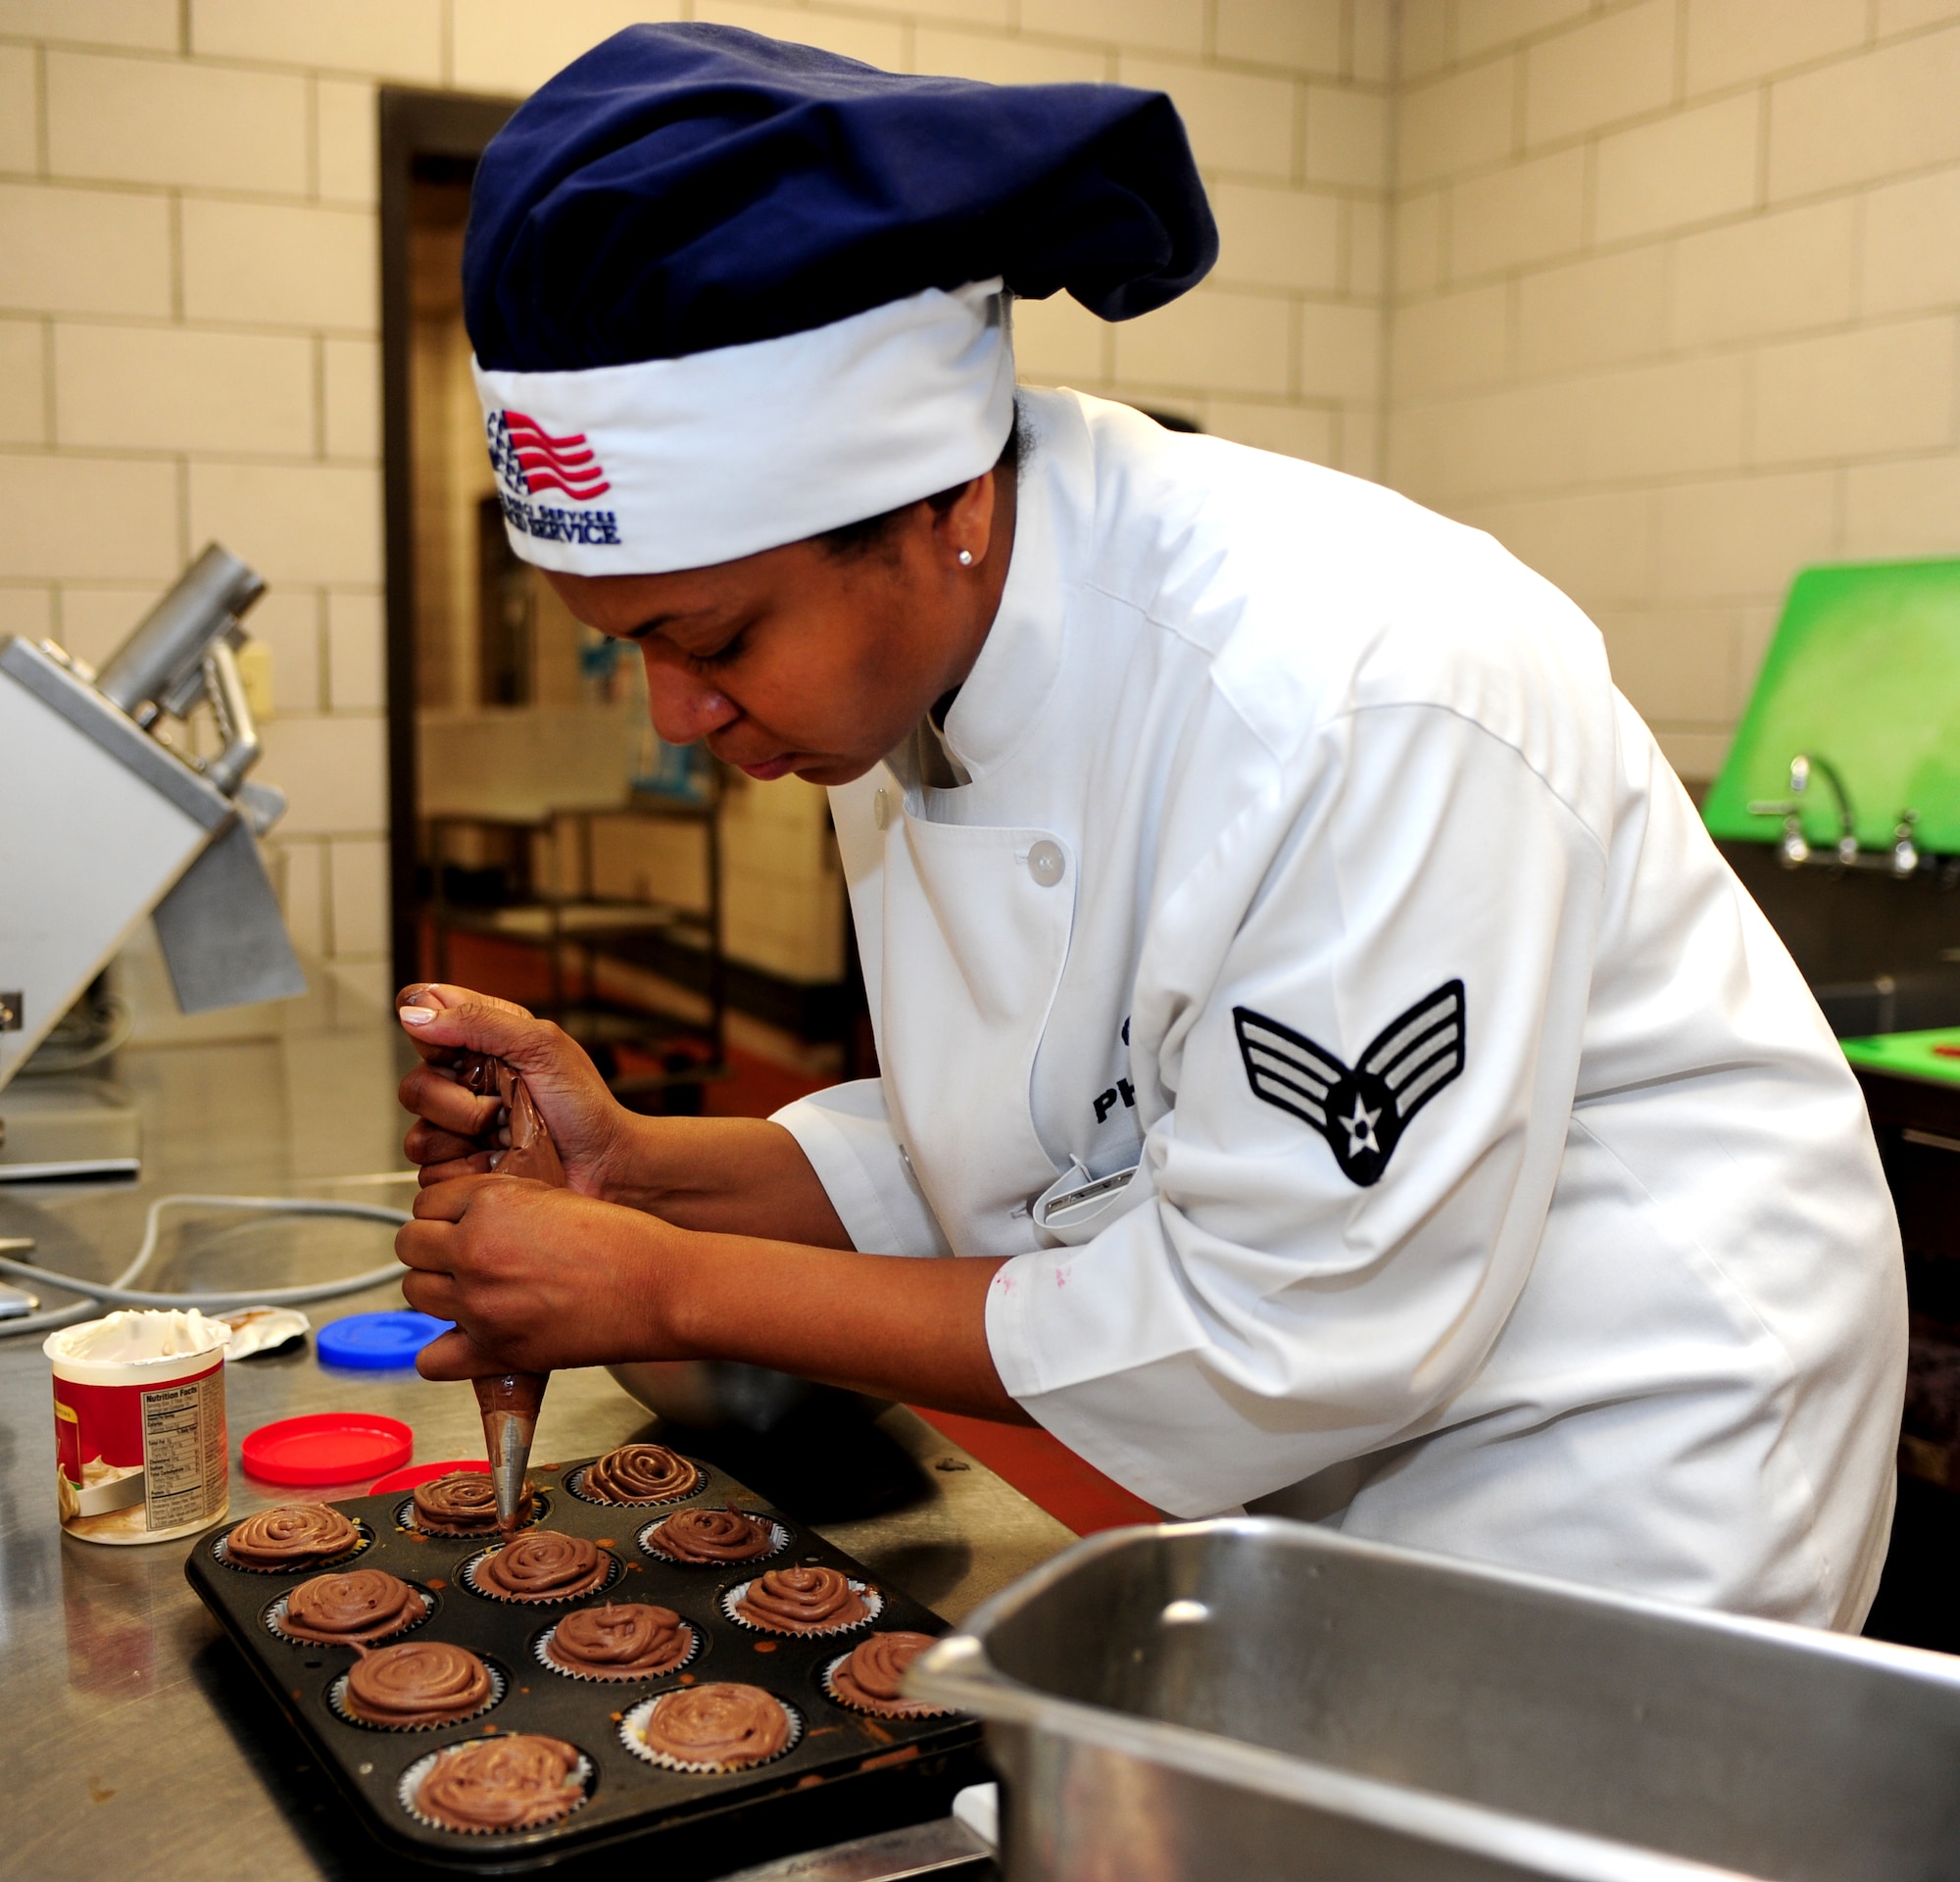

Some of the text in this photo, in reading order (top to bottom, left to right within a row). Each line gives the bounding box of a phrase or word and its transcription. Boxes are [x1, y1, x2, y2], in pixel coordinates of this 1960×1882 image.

[528, 519, 621, 544] SERVICE
[146, 1386, 197, 1403] Nutrition Facts
